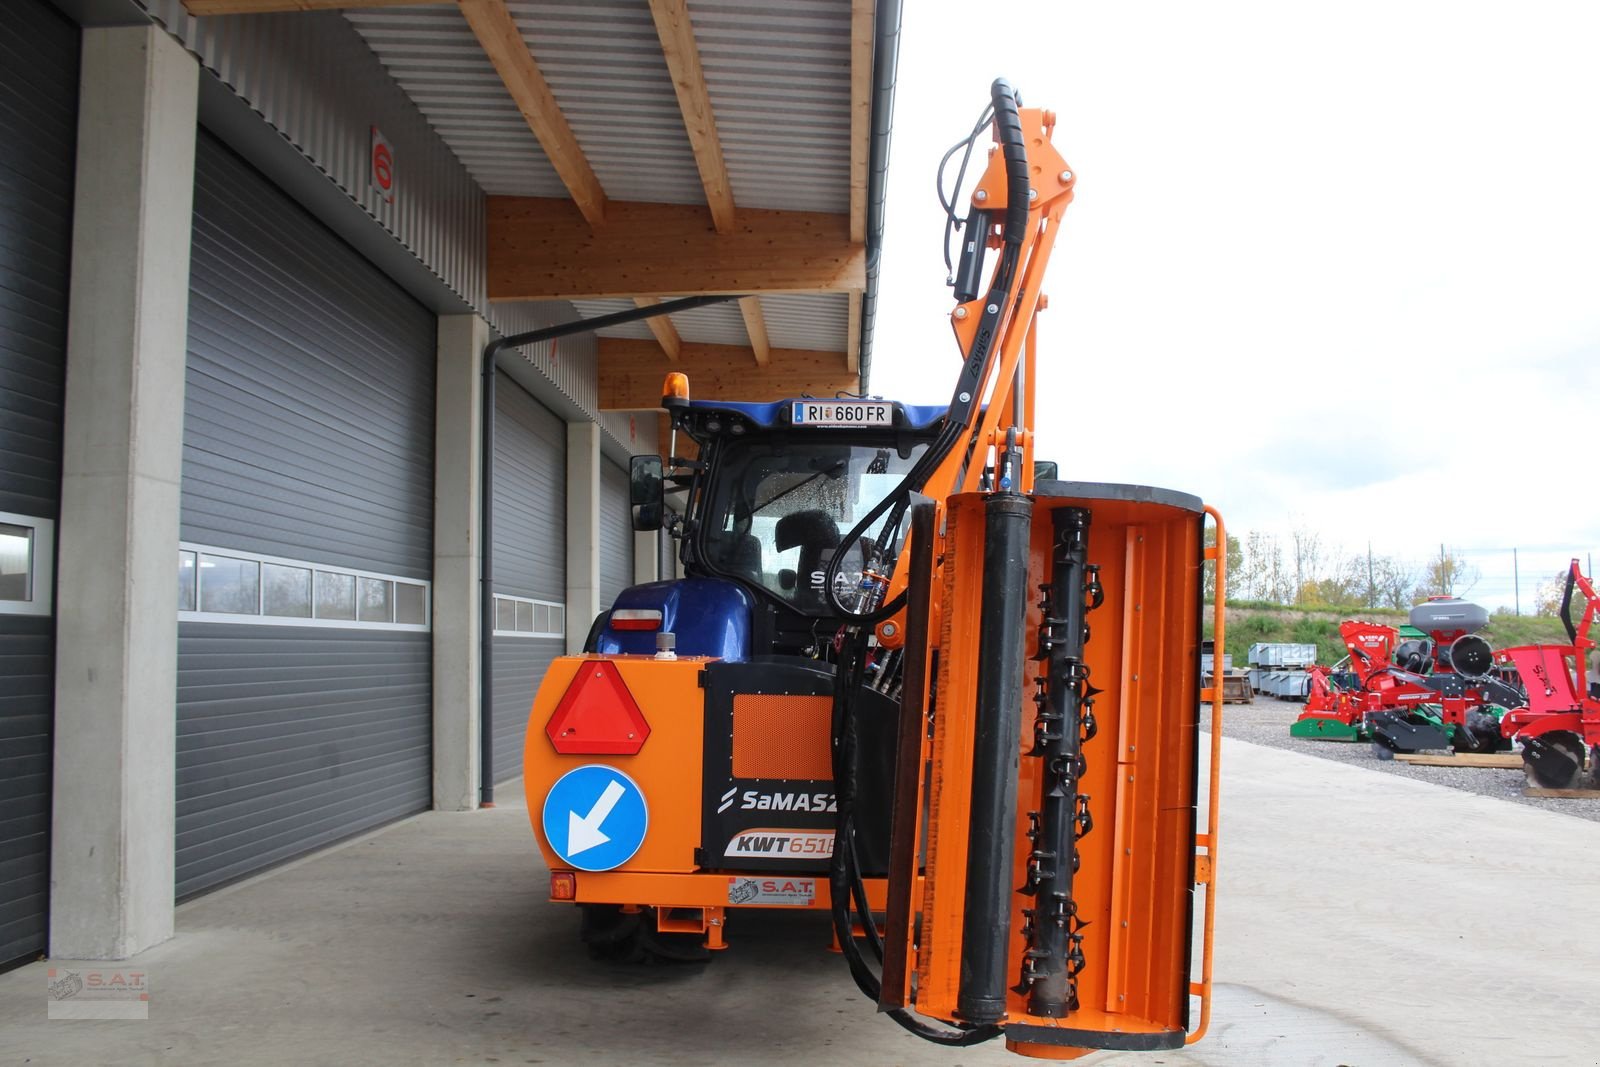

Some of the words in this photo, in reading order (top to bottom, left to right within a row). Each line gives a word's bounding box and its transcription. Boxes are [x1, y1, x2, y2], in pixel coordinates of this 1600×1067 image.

[374, 143, 392, 190] 6
[809, 406, 823, 421] RI
[762, 880, 813, 893] S.A.T.
